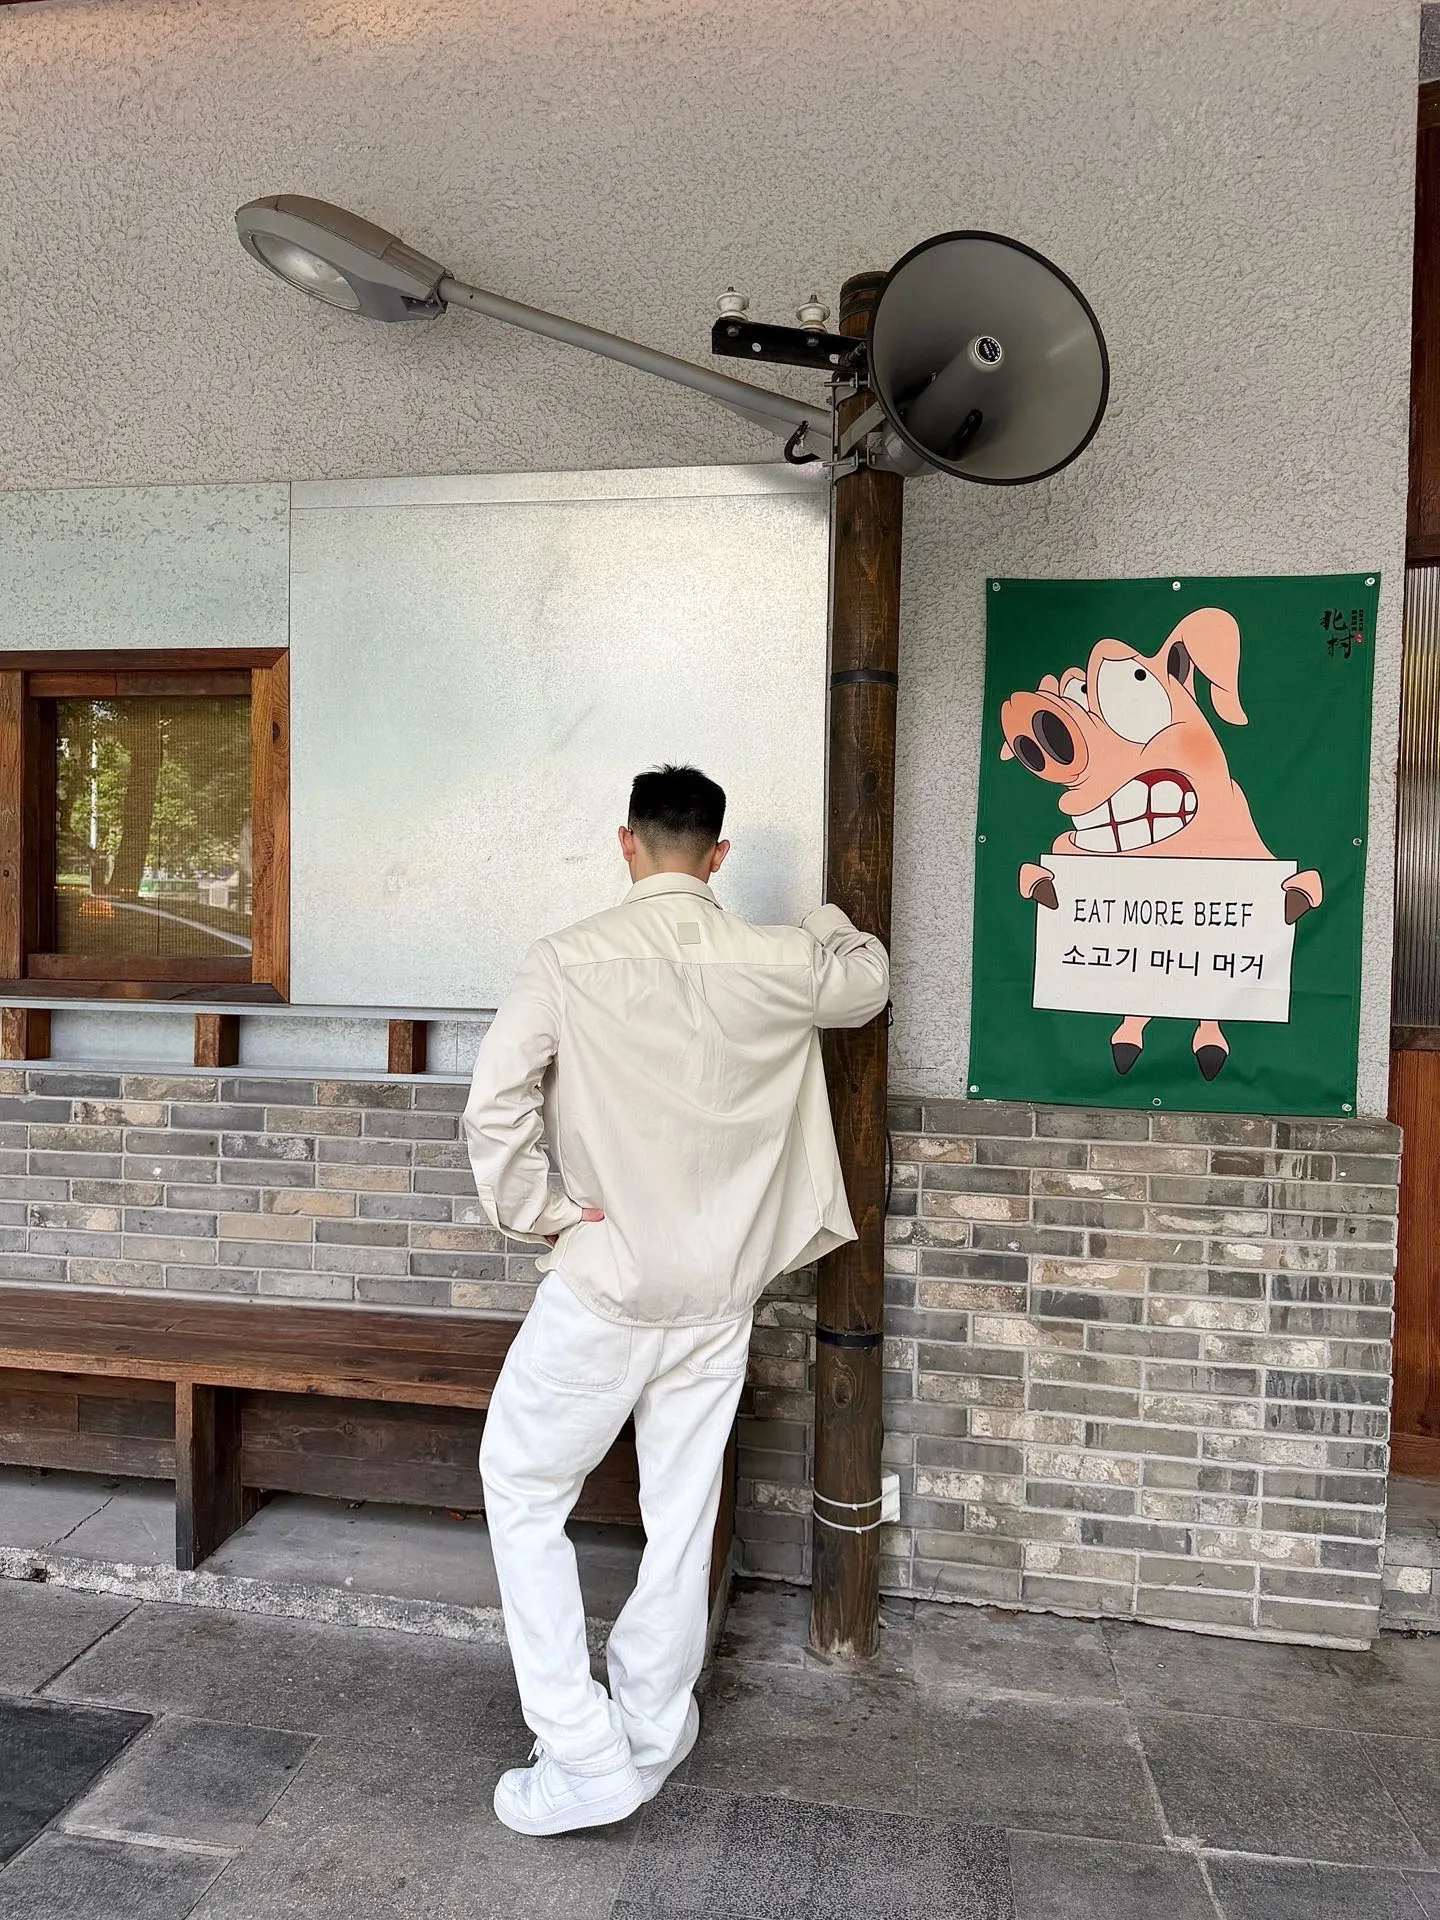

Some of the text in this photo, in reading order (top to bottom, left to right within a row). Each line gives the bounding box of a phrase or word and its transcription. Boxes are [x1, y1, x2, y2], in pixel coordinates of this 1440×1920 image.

[1073, 898, 1254, 928] EAT MORE BEEF
[1061, 945, 1264, 980] 소고기 마니 머거
